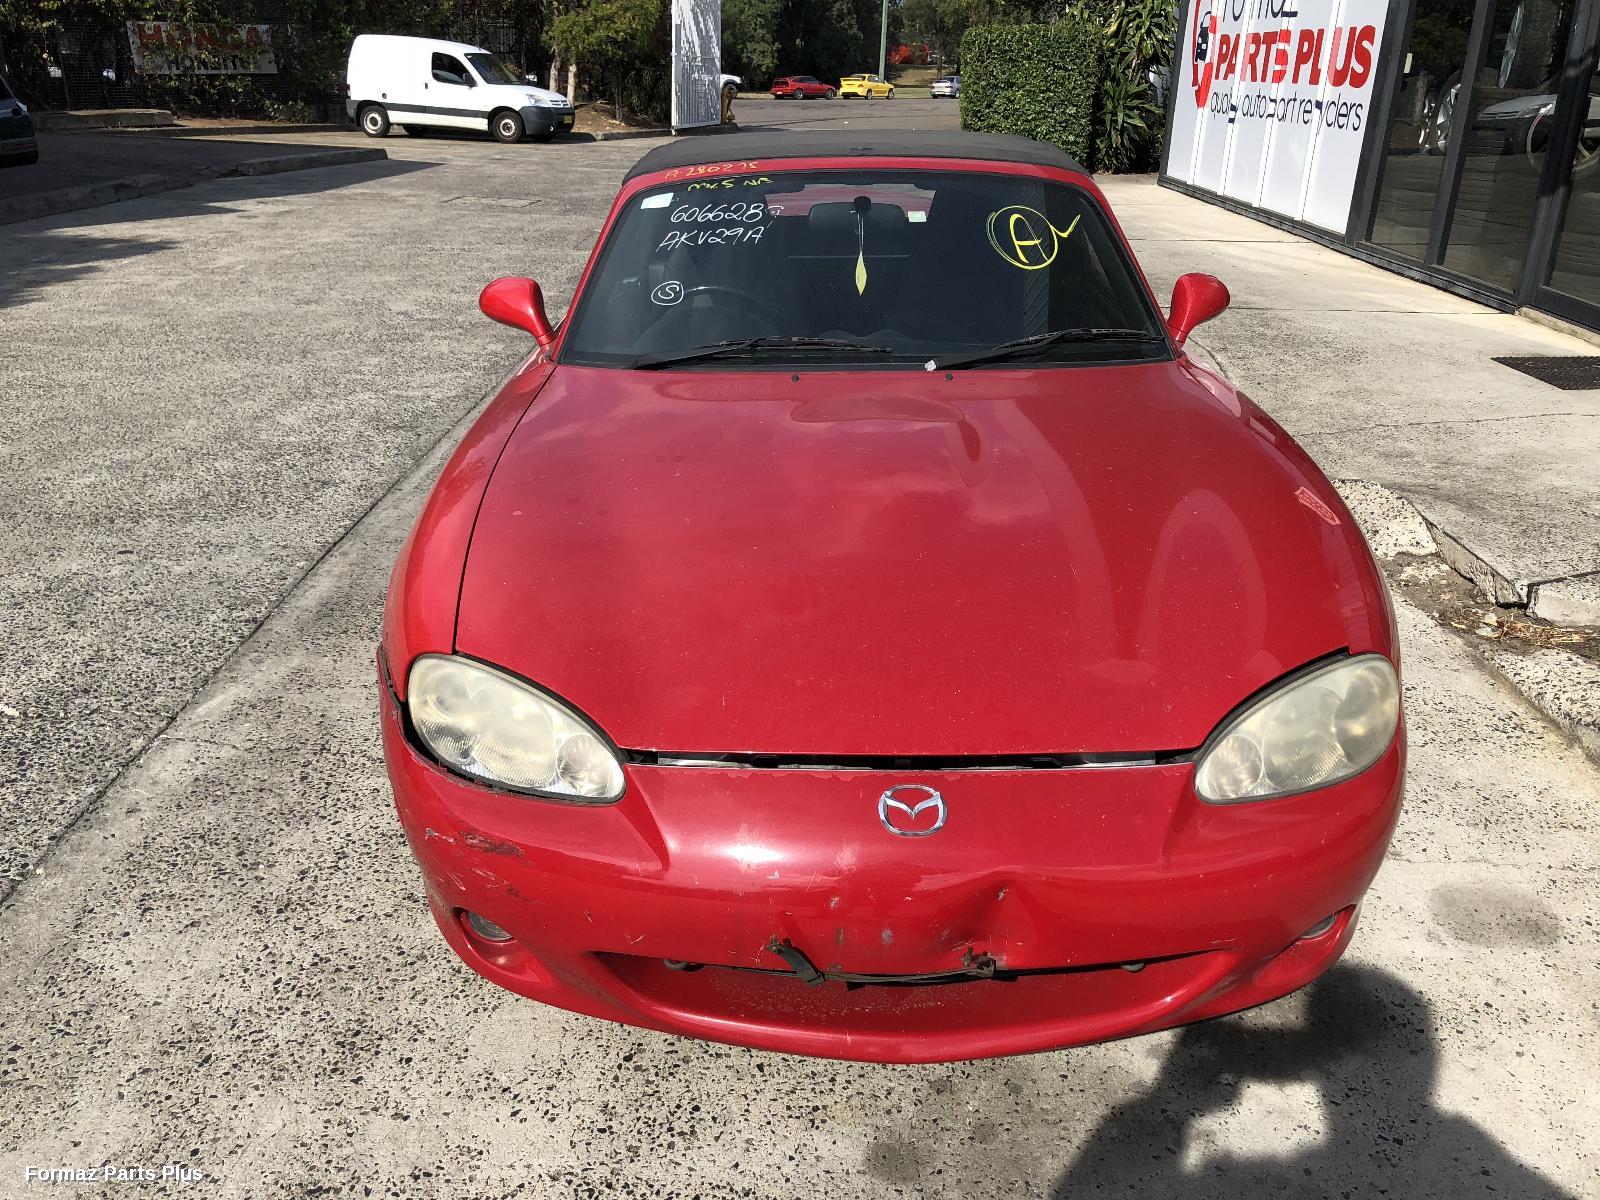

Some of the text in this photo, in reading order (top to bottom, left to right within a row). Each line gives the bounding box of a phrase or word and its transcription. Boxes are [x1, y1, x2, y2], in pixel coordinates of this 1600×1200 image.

[1214, 24, 1377, 89] PARTS PLUS
[670, 202, 765, 223] 606628
